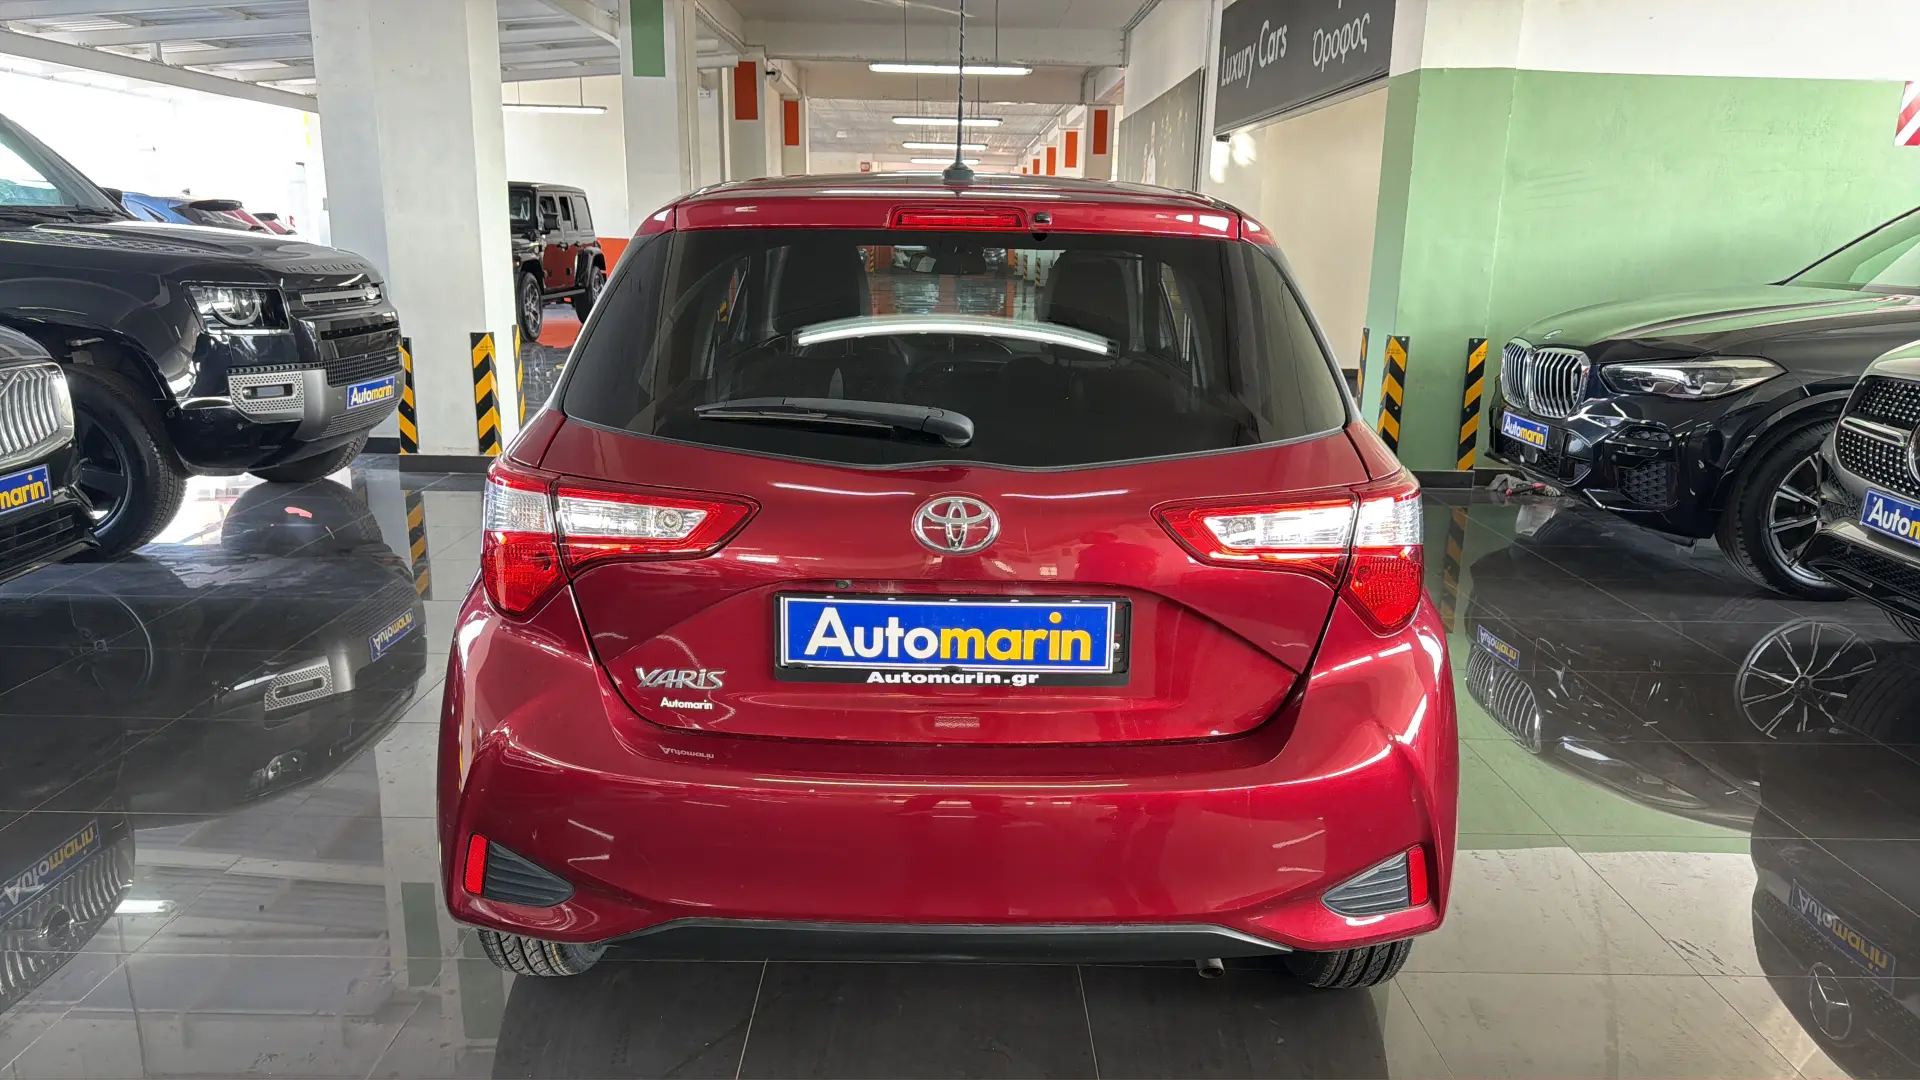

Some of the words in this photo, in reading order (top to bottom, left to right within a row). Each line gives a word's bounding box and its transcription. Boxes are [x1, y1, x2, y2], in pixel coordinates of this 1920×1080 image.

[1221, 42, 1257, 88] Luxury
[1258, 19, 1288, 68] Cars
[350, 379, 393, 405] Automarin
[1503, 415, 1545, 446] Automarin
[804, 606, 1092, 662] Automarin
[866, 671, 1039, 686] Automarin.gr
[660, 697, 713, 710] Automarin
